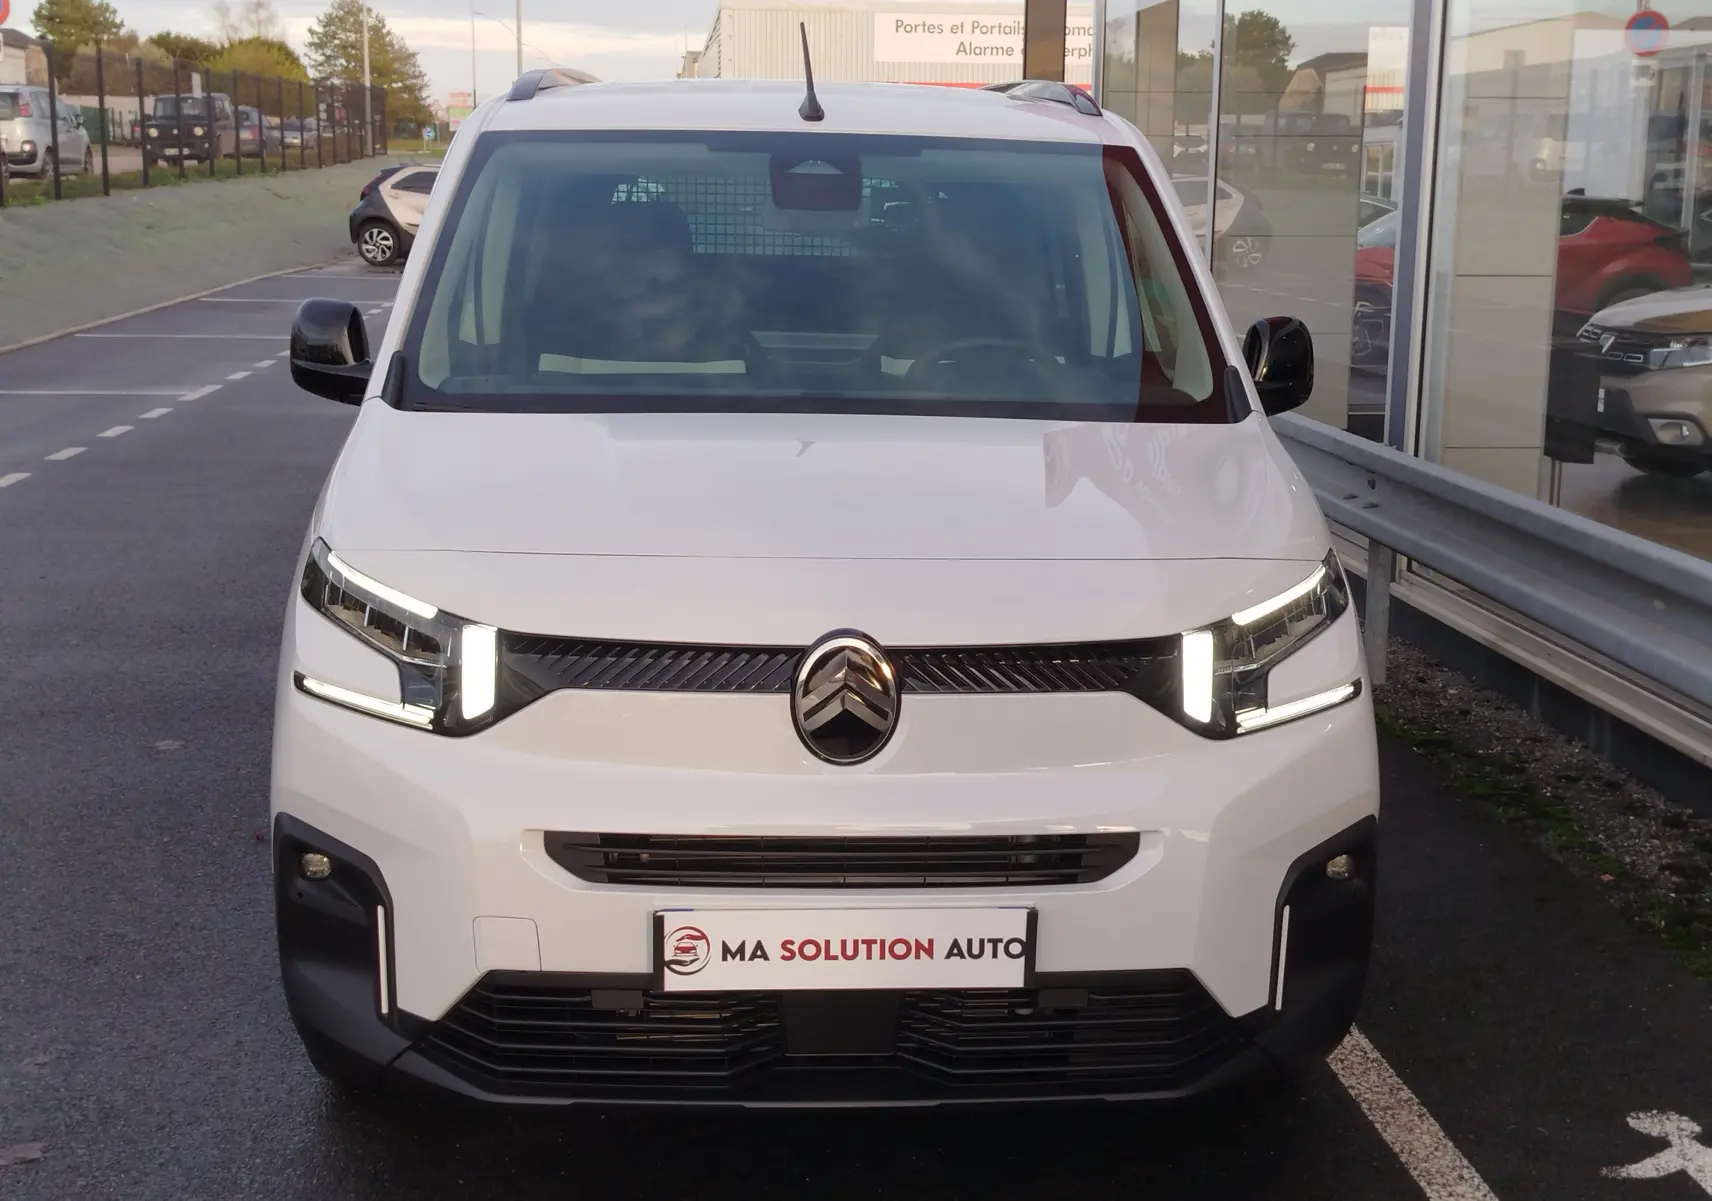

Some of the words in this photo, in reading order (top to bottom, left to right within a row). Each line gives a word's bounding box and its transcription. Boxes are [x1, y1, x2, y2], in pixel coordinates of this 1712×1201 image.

[895, 19, 944, 35] Portes
[950, 21, 965, 35] et
[956, 41, 1015, 57] Alarme
[721, 939, 771, 962] MA
[779, 937, 935, 962] SOLUTION
[943, 937, 1027, 960] AUTO
